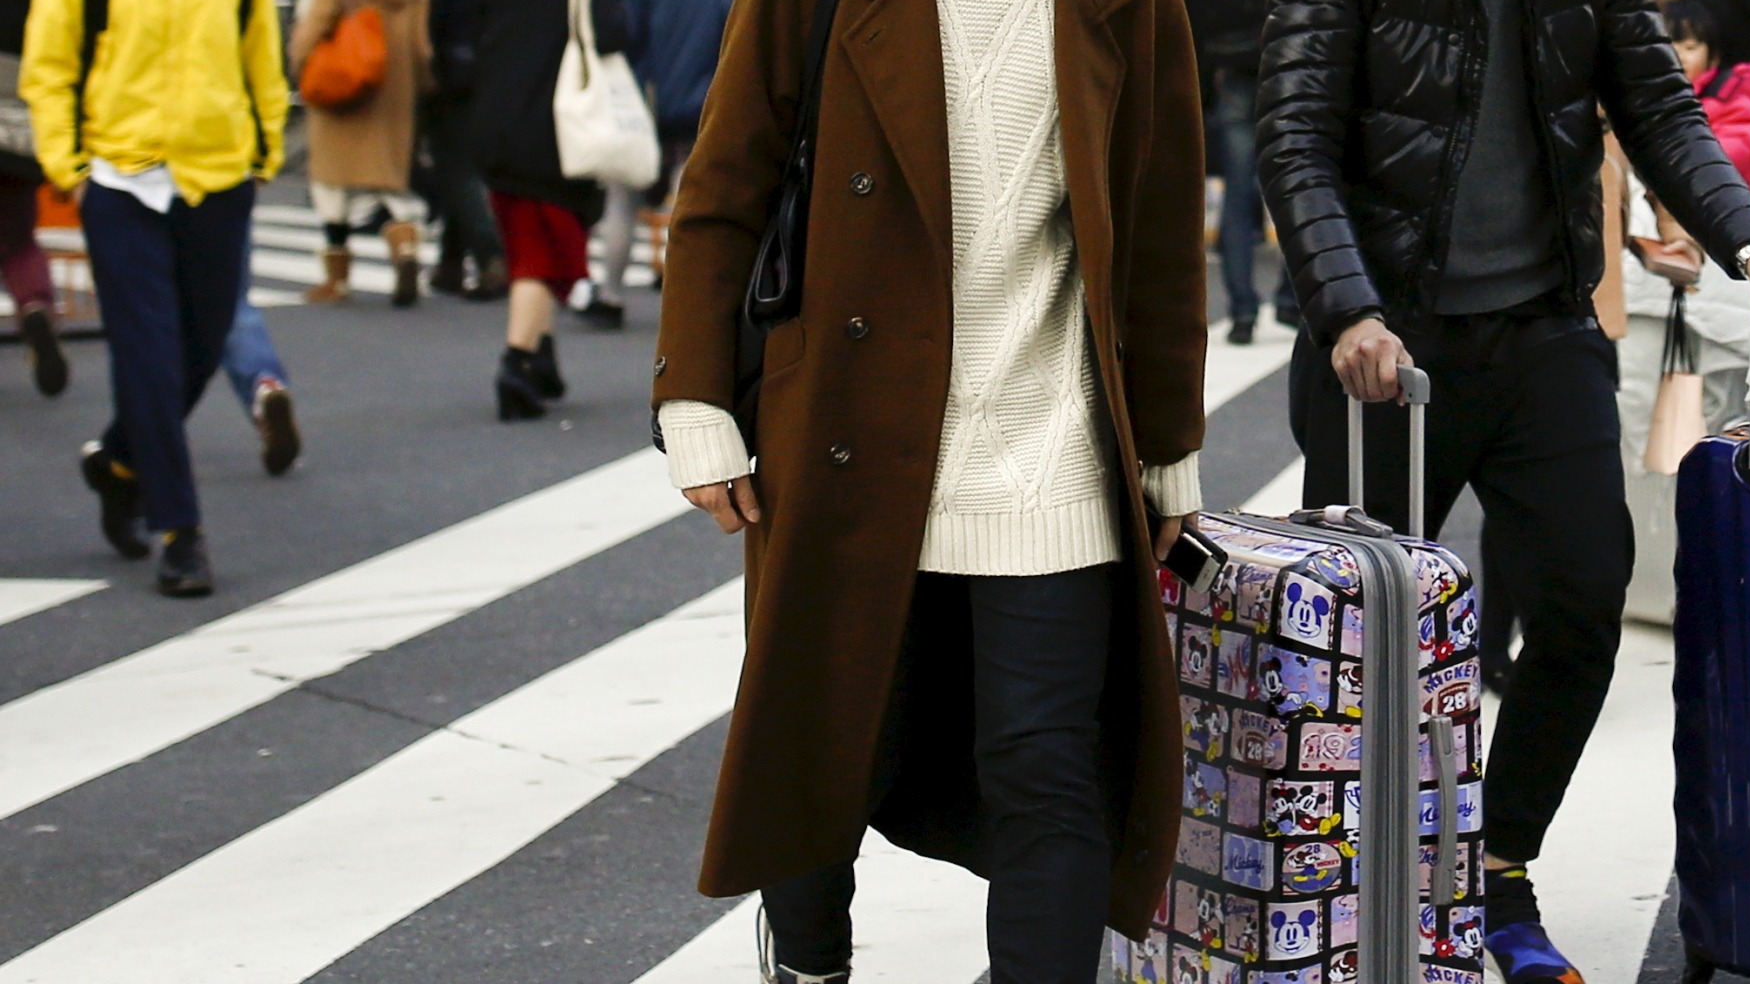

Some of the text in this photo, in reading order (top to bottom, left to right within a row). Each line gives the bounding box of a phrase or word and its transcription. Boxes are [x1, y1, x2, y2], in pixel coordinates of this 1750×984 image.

[1423, 664, 1478, 694] MICKEY
[1442, 691, 1467, 714] 28
[1247, 740, 1263, 761] 28
[1305, 844, 1321, 854] 28
[1224, 852, 1265, 875] Mickey
